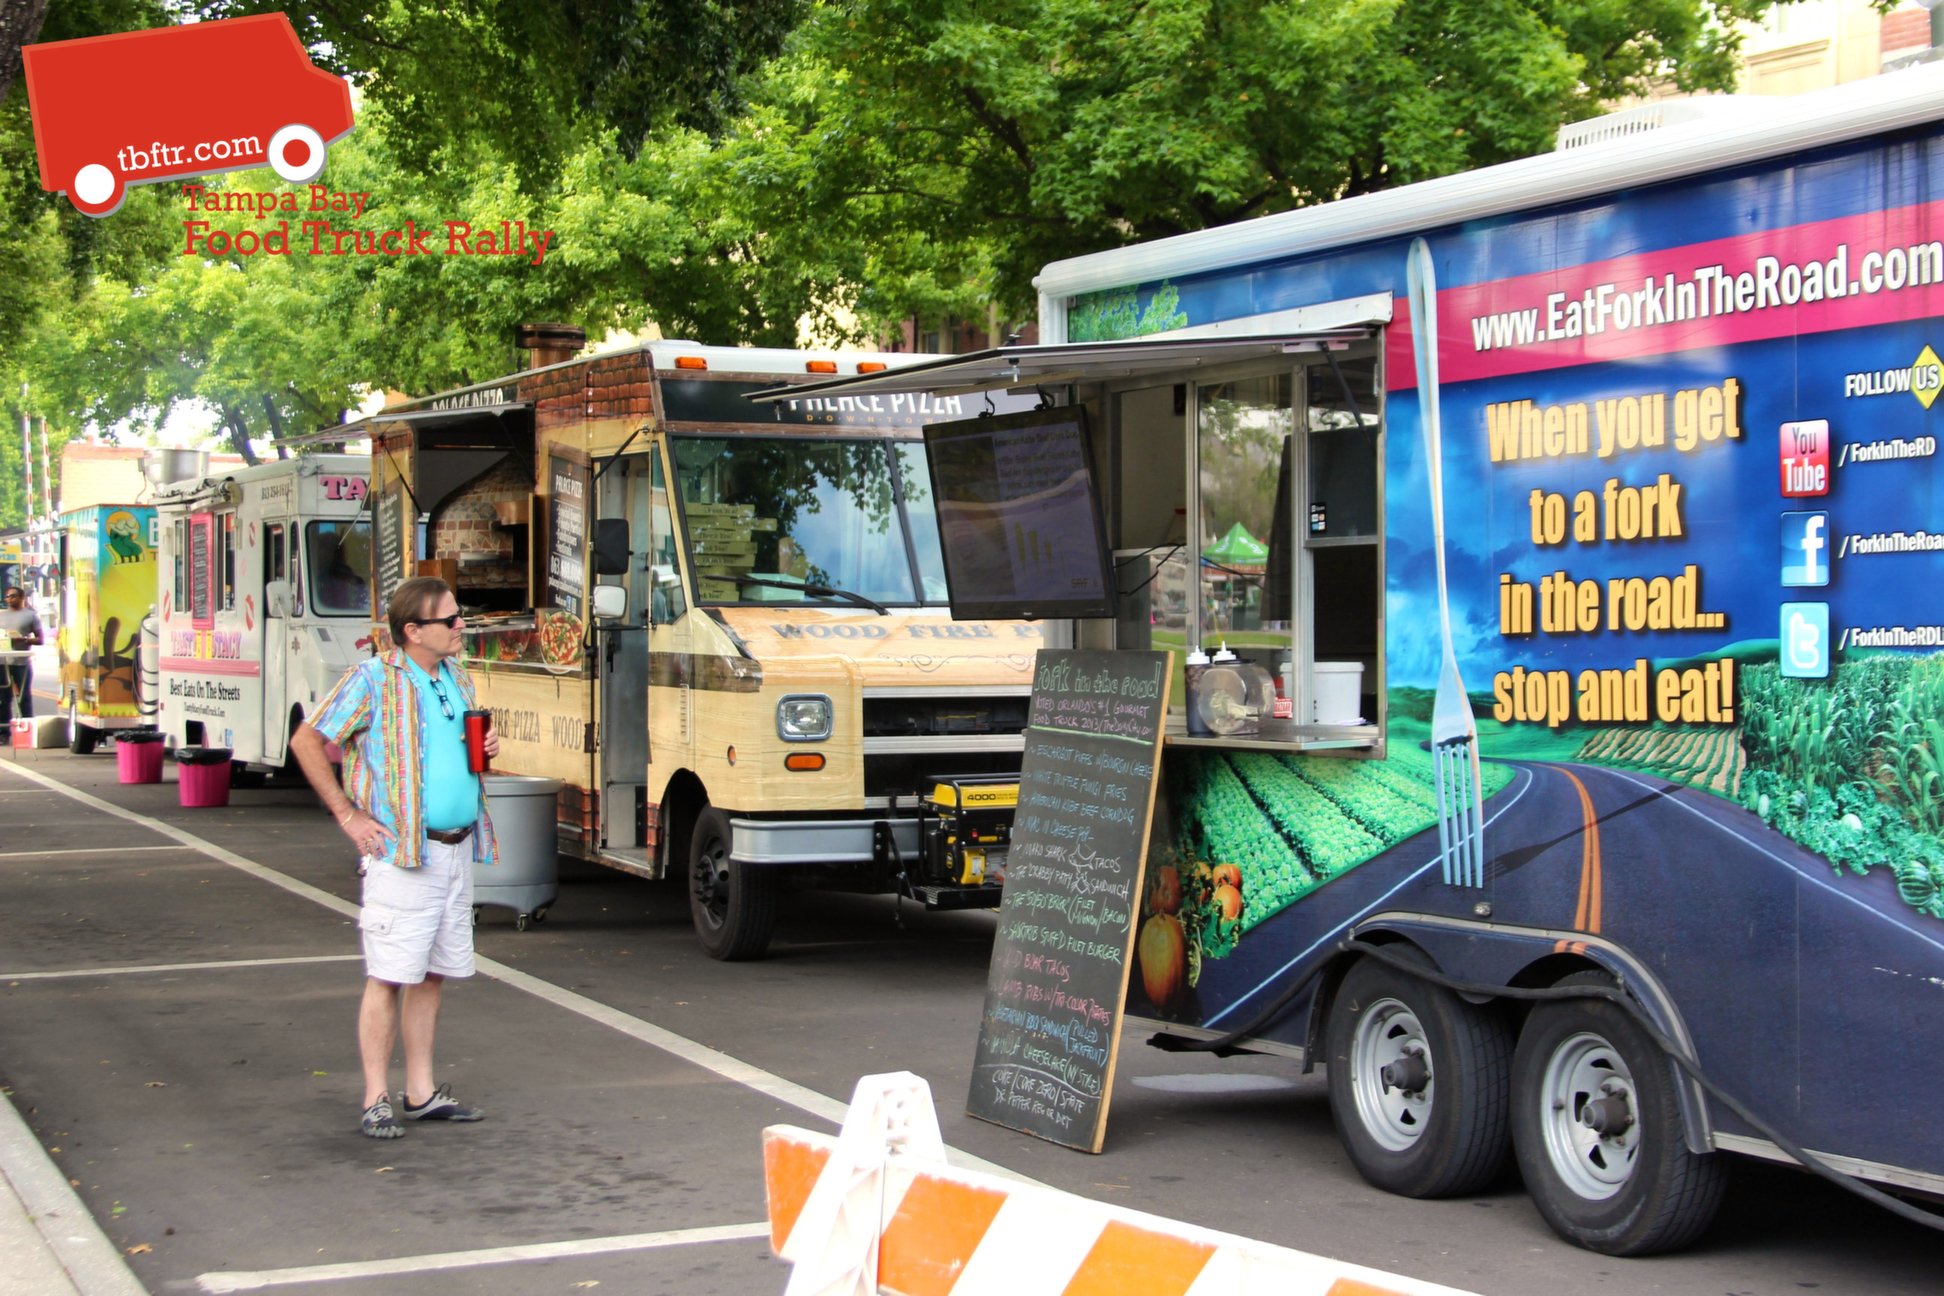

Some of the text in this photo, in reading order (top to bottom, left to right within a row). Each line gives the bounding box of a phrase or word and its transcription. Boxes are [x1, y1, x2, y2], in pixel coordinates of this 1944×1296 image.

[1472, 240, 1943, 352] www.EatForkInTheRoad.com
[1844, 365, 1939, 398] FOLLOW US
[1487, 377, 1740, 462] When you get
[1792, 427, 1817, 455] You
[1782, 457, 1825, 492] Tube
[1530, 474, 1682, 545] to a fork
[1499, 565, 1724, 634] in the road...
[770, 623, 887, 639] WOOD
[906, 623, 993, 639] FIRE
[206, 682, 217, 699] The
[1493, 658, 1734, 727] stop and eat!
[514, 709, 541, 743] PIZZA
[552, 715, 582, 750] WOOD
[967, 793, 996, 801] 4000
[1095, 856, 1121, 873] TACOS
[1087, 942, 1122, 965] BURGER
[1046, 959, 1070, 983] TACOS
